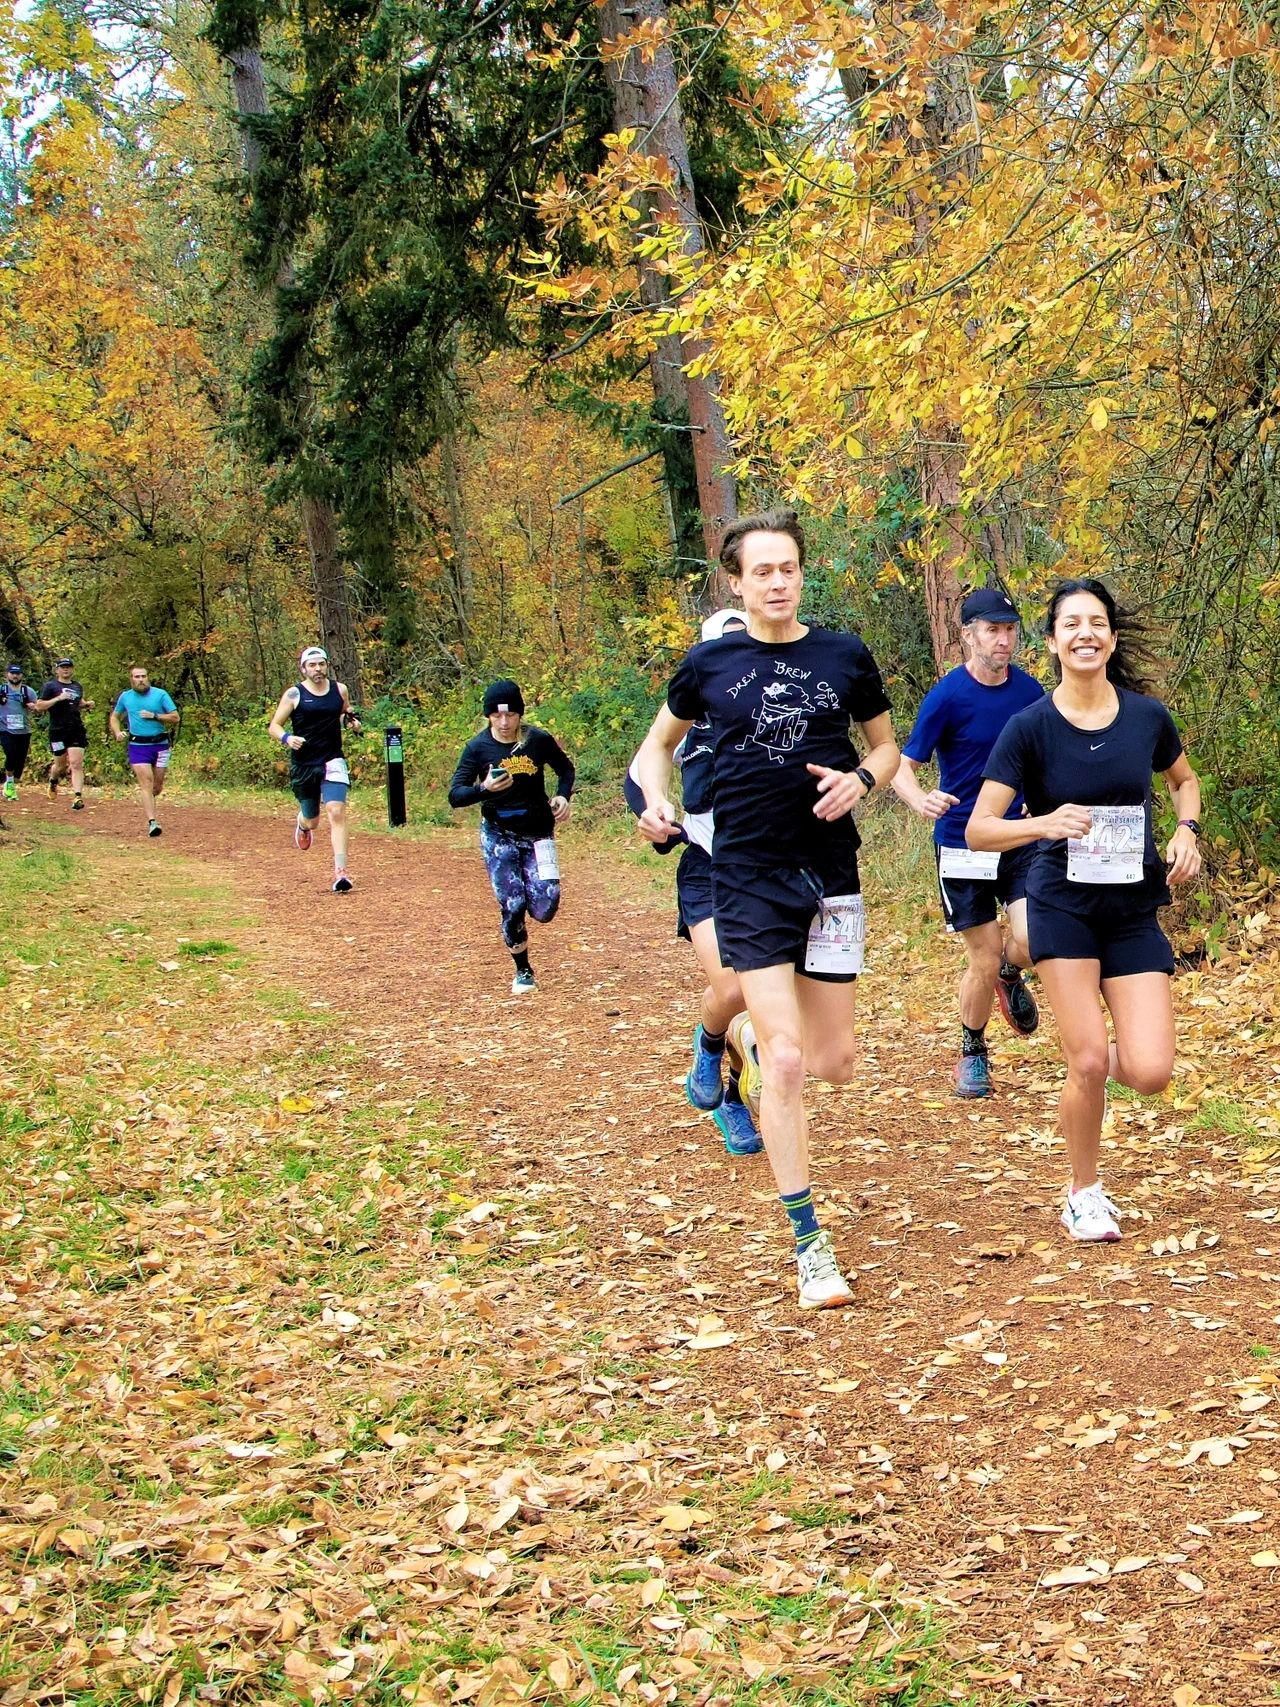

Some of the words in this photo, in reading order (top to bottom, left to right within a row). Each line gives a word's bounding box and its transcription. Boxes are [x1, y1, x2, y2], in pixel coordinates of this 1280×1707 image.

[725, 668, 758, 699] DREW
[773, 660, 812, 680] BREW
[816, 681, 841, 710] CREW
[1080, 824, 1132, 853] 442
